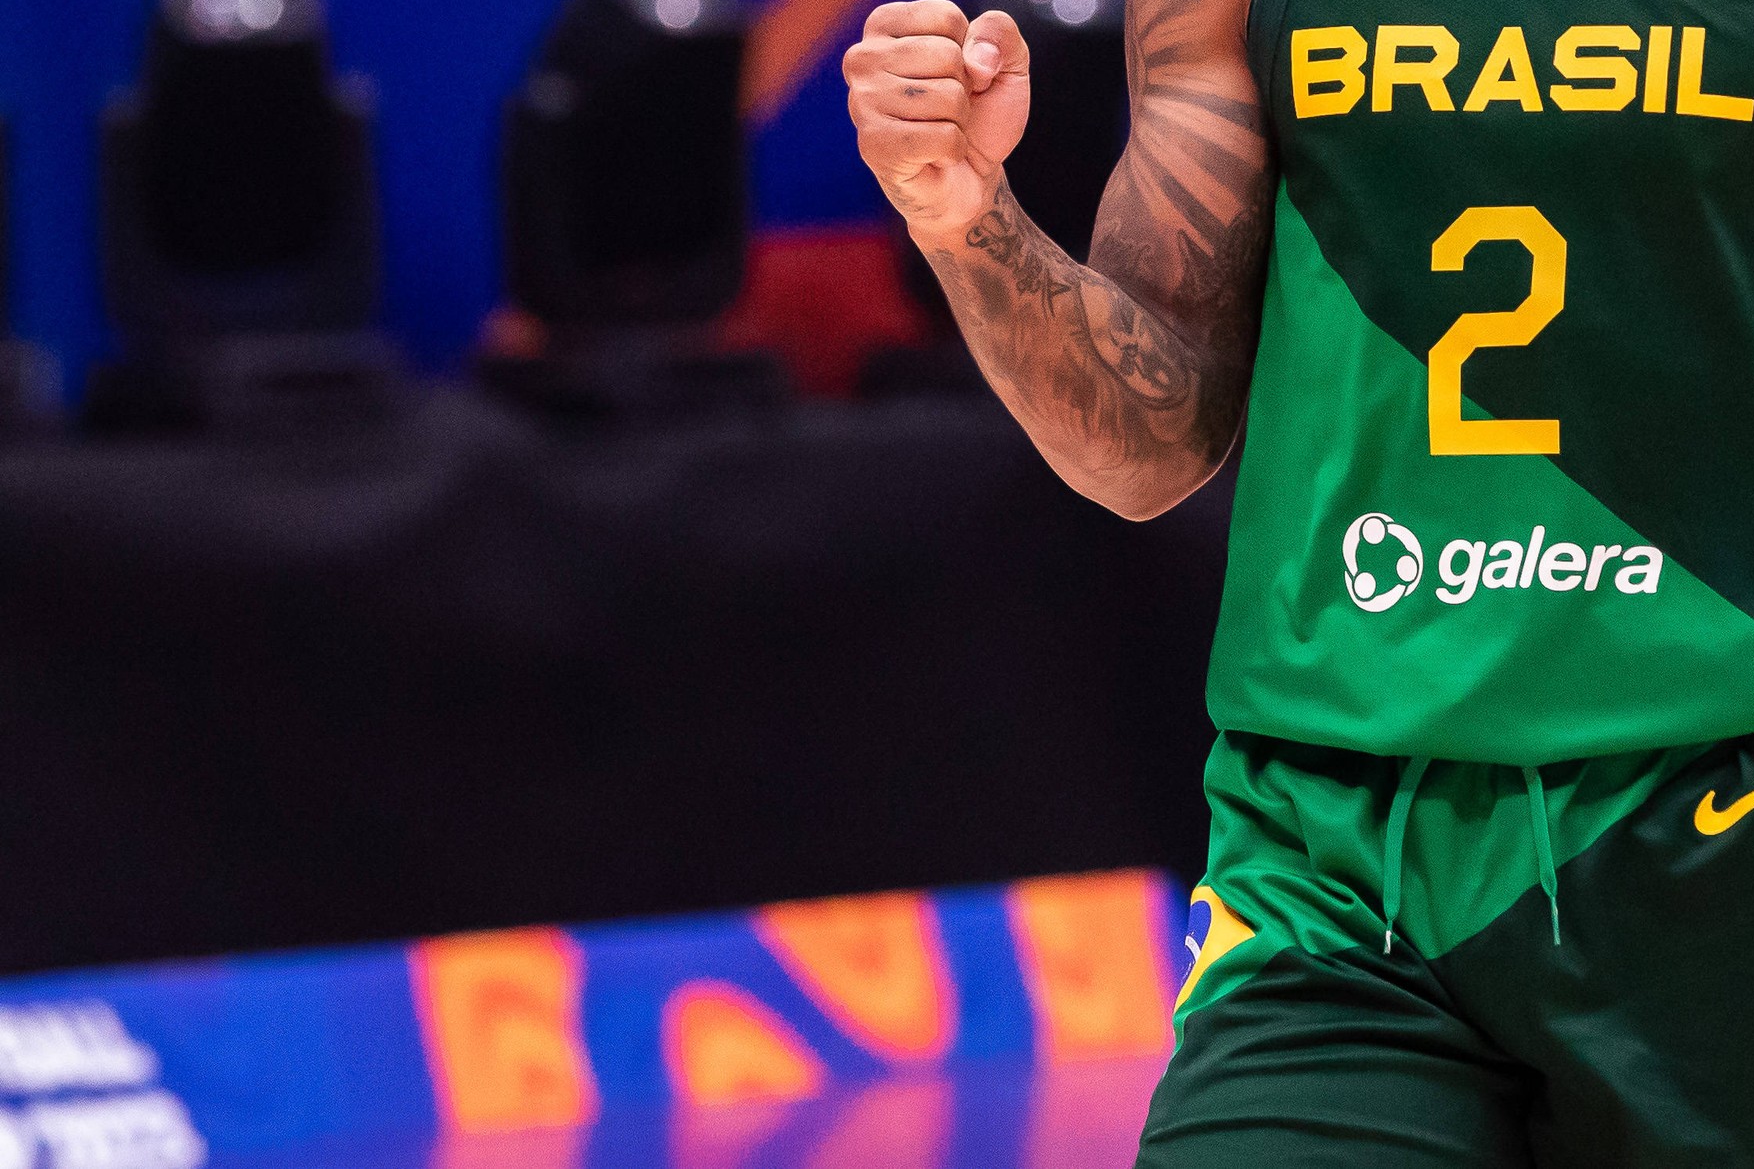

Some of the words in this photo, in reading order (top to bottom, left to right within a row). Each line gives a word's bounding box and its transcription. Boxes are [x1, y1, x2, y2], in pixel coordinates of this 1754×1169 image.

[1291, 25, 1754, 121] BRASIL
[1428, 205, 1567, 456] 2
[1435, 525, 1664, 605] galera
